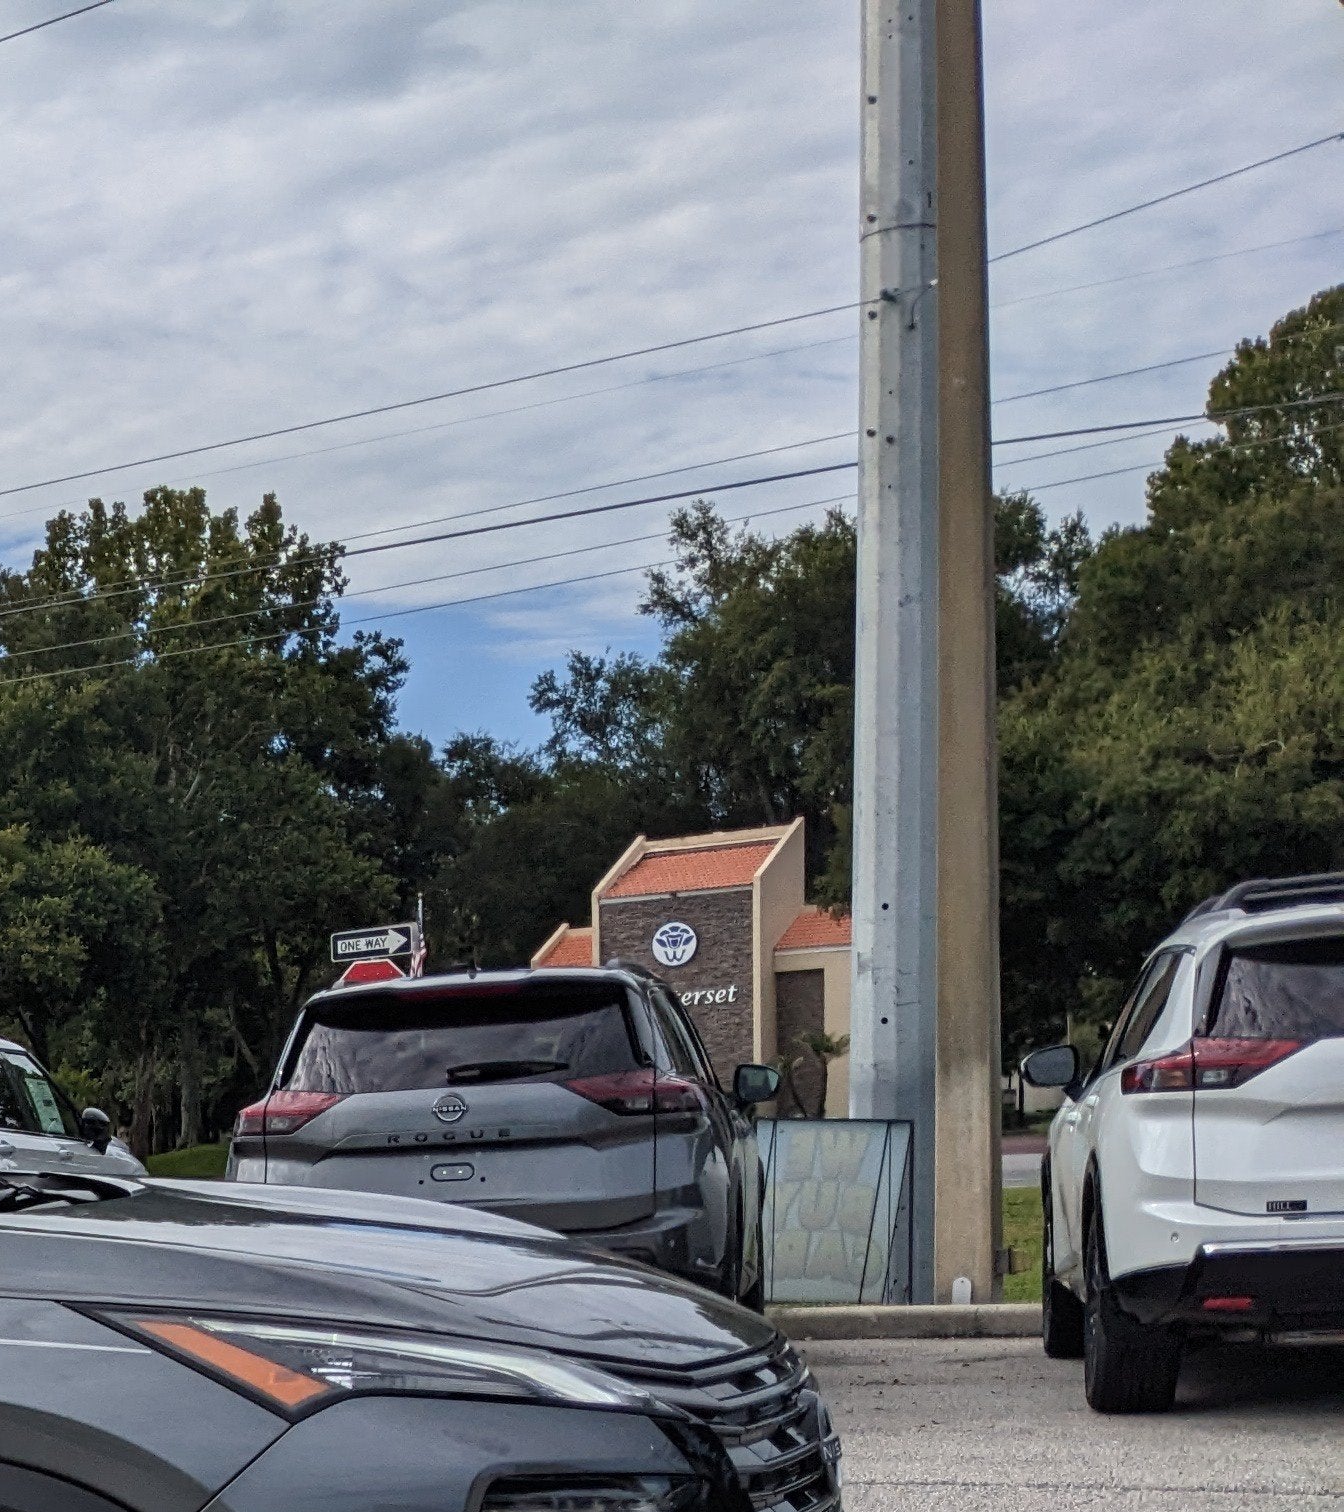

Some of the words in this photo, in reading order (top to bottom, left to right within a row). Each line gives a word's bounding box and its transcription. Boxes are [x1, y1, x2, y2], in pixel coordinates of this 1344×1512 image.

[340, 940, 361, 952] ONE
[365, 936, 388, 949] WAY
[387, 1128, 511, 1144] ROGUE
